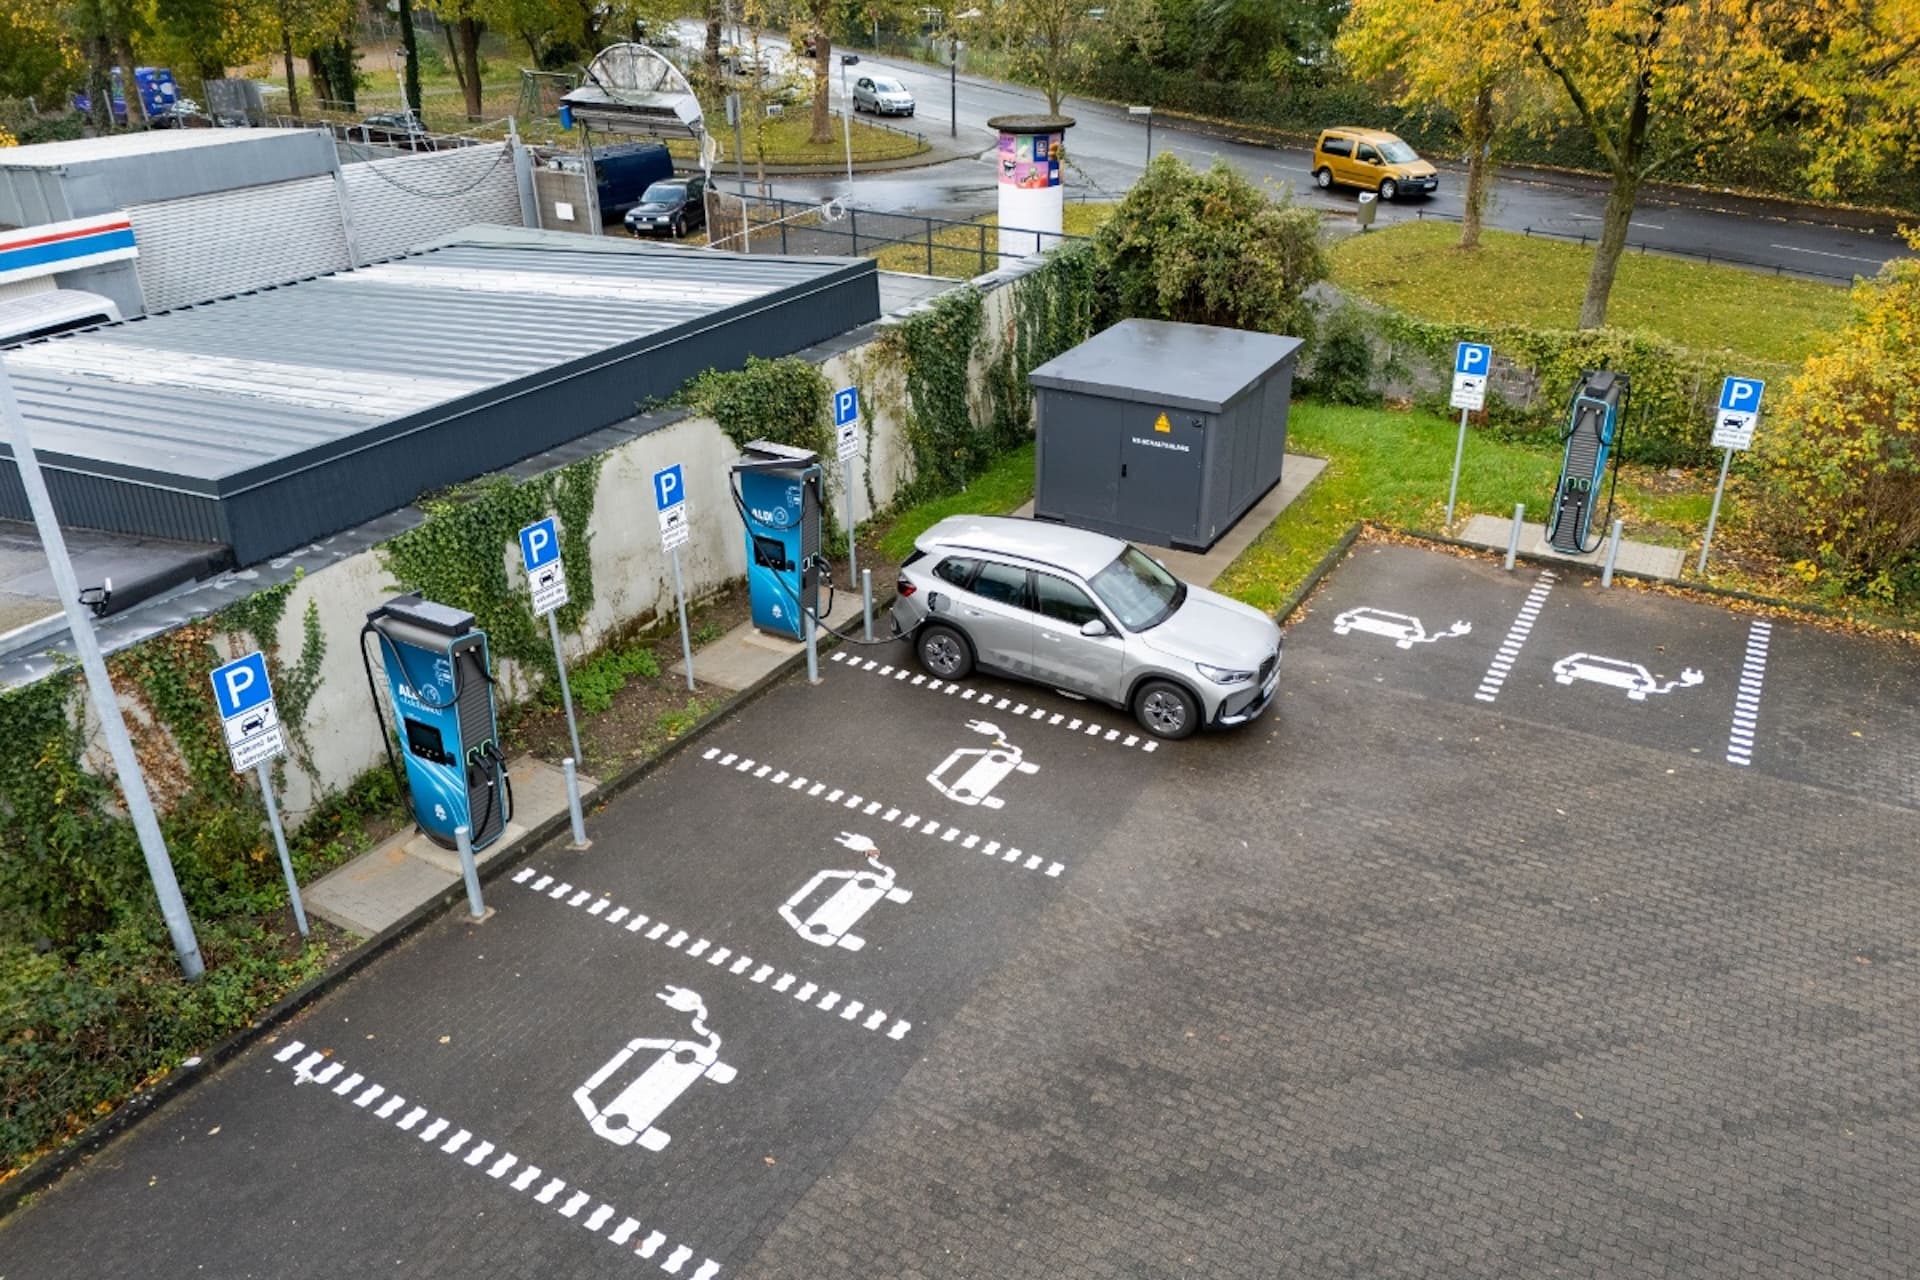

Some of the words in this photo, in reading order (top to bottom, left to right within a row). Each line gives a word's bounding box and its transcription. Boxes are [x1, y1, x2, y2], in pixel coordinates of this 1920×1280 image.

[1464, 348, 1482, 370] P
[841, 393, 852, 420] P
[1729, 382, 1753, 407] P
[661, 473, 677, 504] P
[528, 528, 548, 564] P
[225, 666, 254, 708] P
